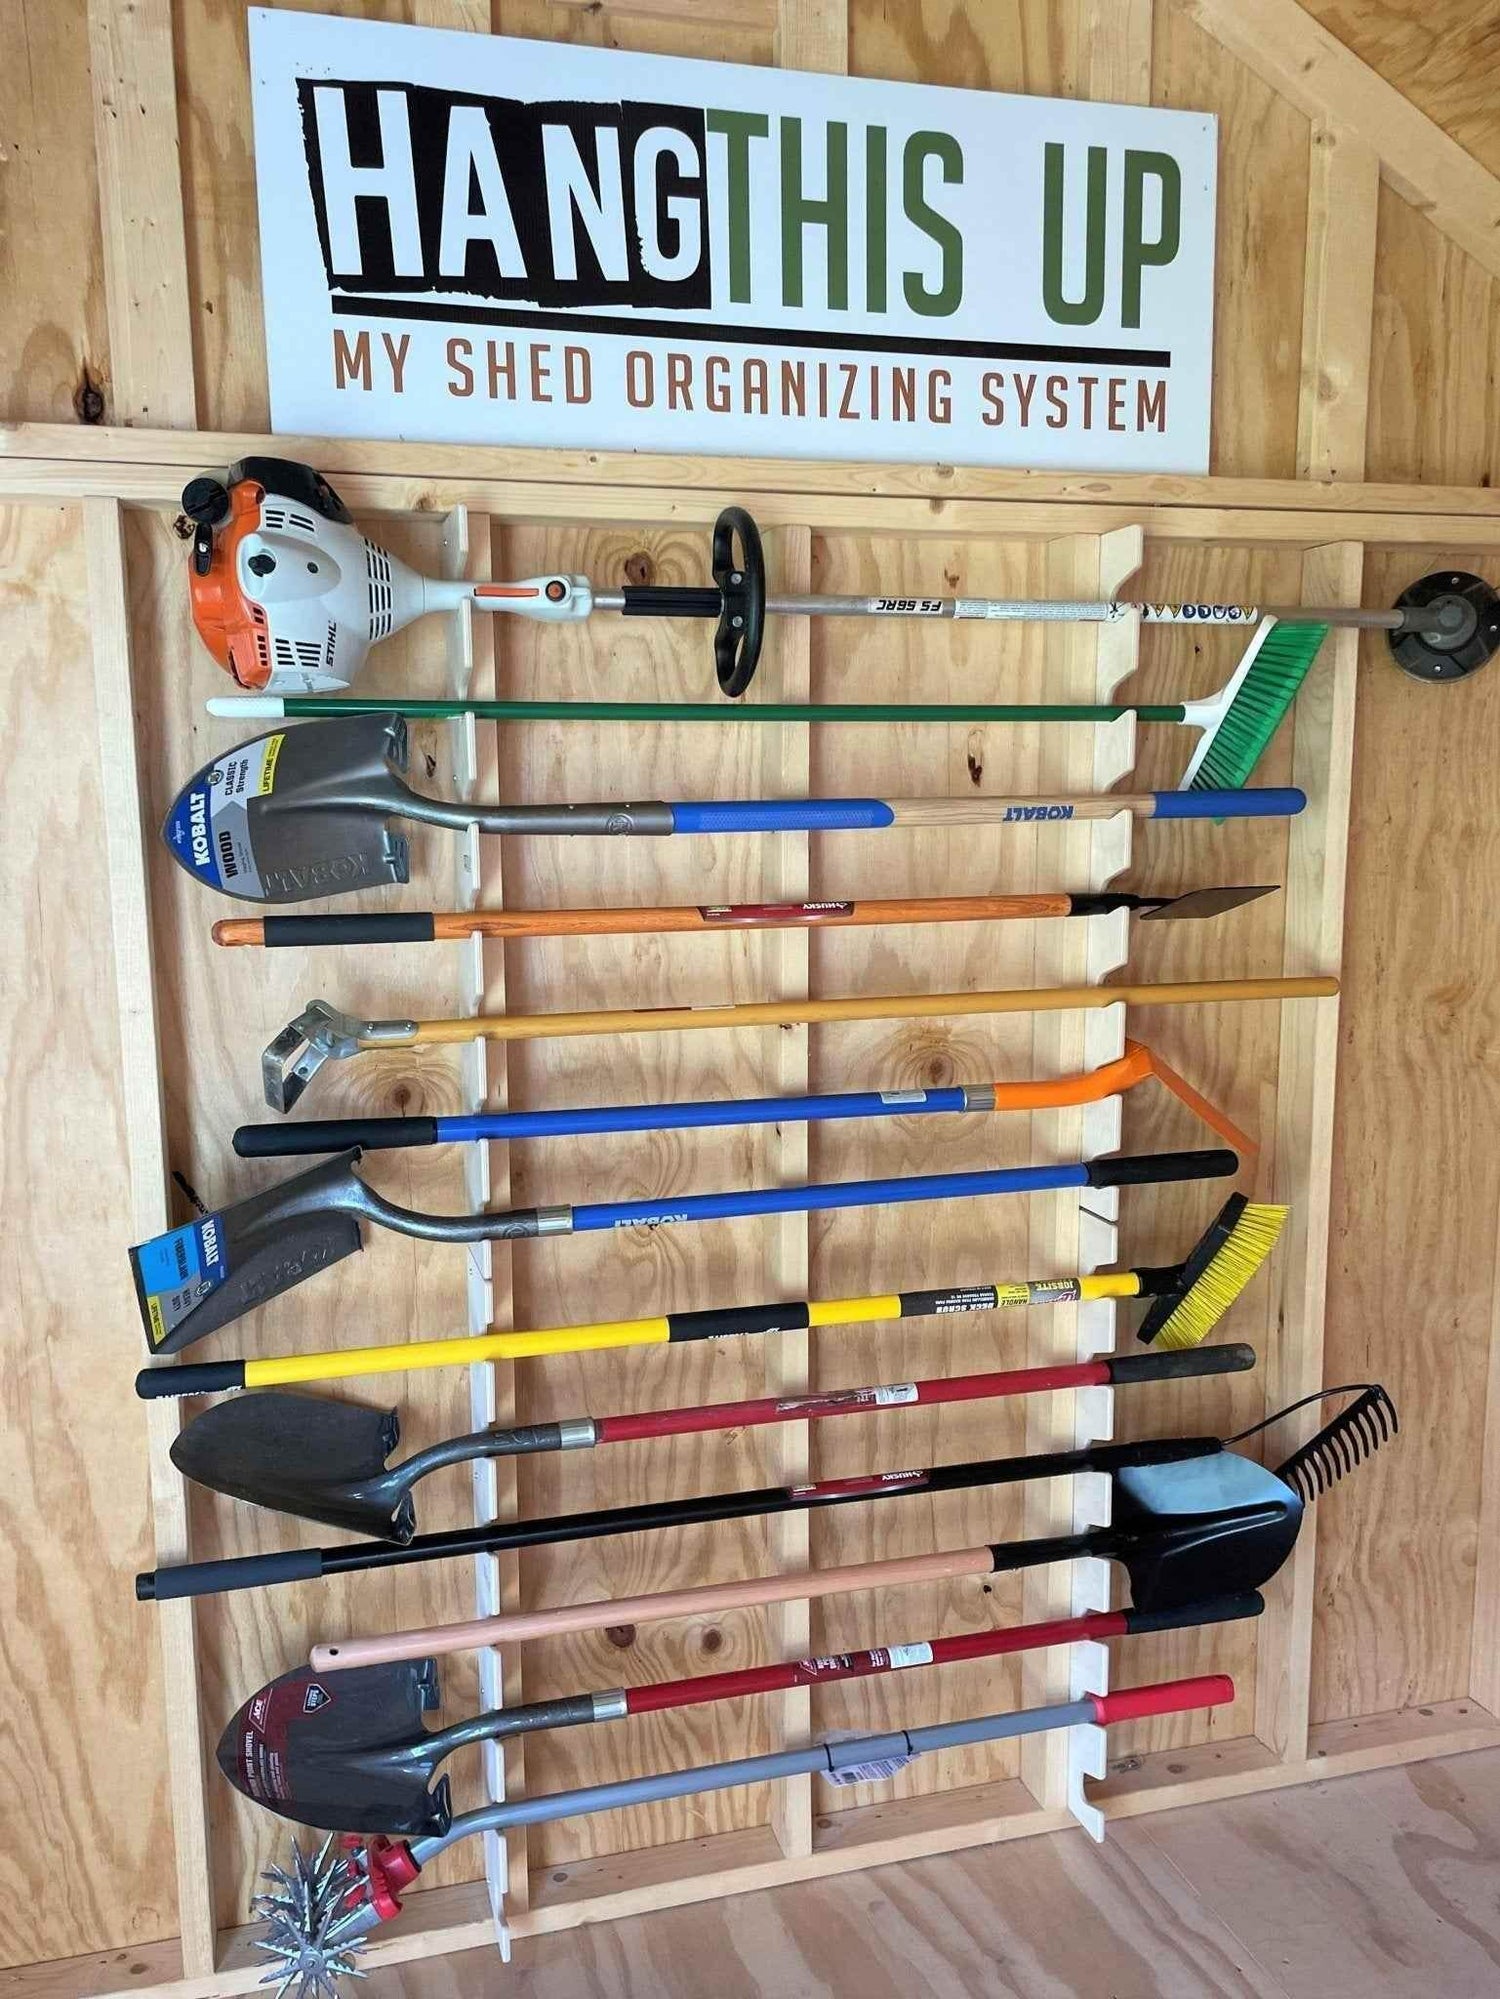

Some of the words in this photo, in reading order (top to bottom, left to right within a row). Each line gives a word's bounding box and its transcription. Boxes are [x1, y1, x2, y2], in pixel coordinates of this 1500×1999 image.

[1043, 141, 1182, 329] UP
[334, 328, 411, 393] MY
[447, 337, 592, 405] SHED
[626, 350, 953, 425] ORGANIZING
[981, 372, 1168, 434] SYSTEM
[920, 601, 942, 611] FS
[325, 622, 337, 667] STIHL
[225, 760, 238, 796] CLASSIC
[236, 758, 249, 794] Strength
[190, 792, 210, 866] KOBALT
[1003, 805, 1074, 822] KOBALT
[219, 831, 239, 878] WOOD
[202, 1219, 220, 1267] KOBALT
[245, 1731, 254, 1758] SHOVEL
